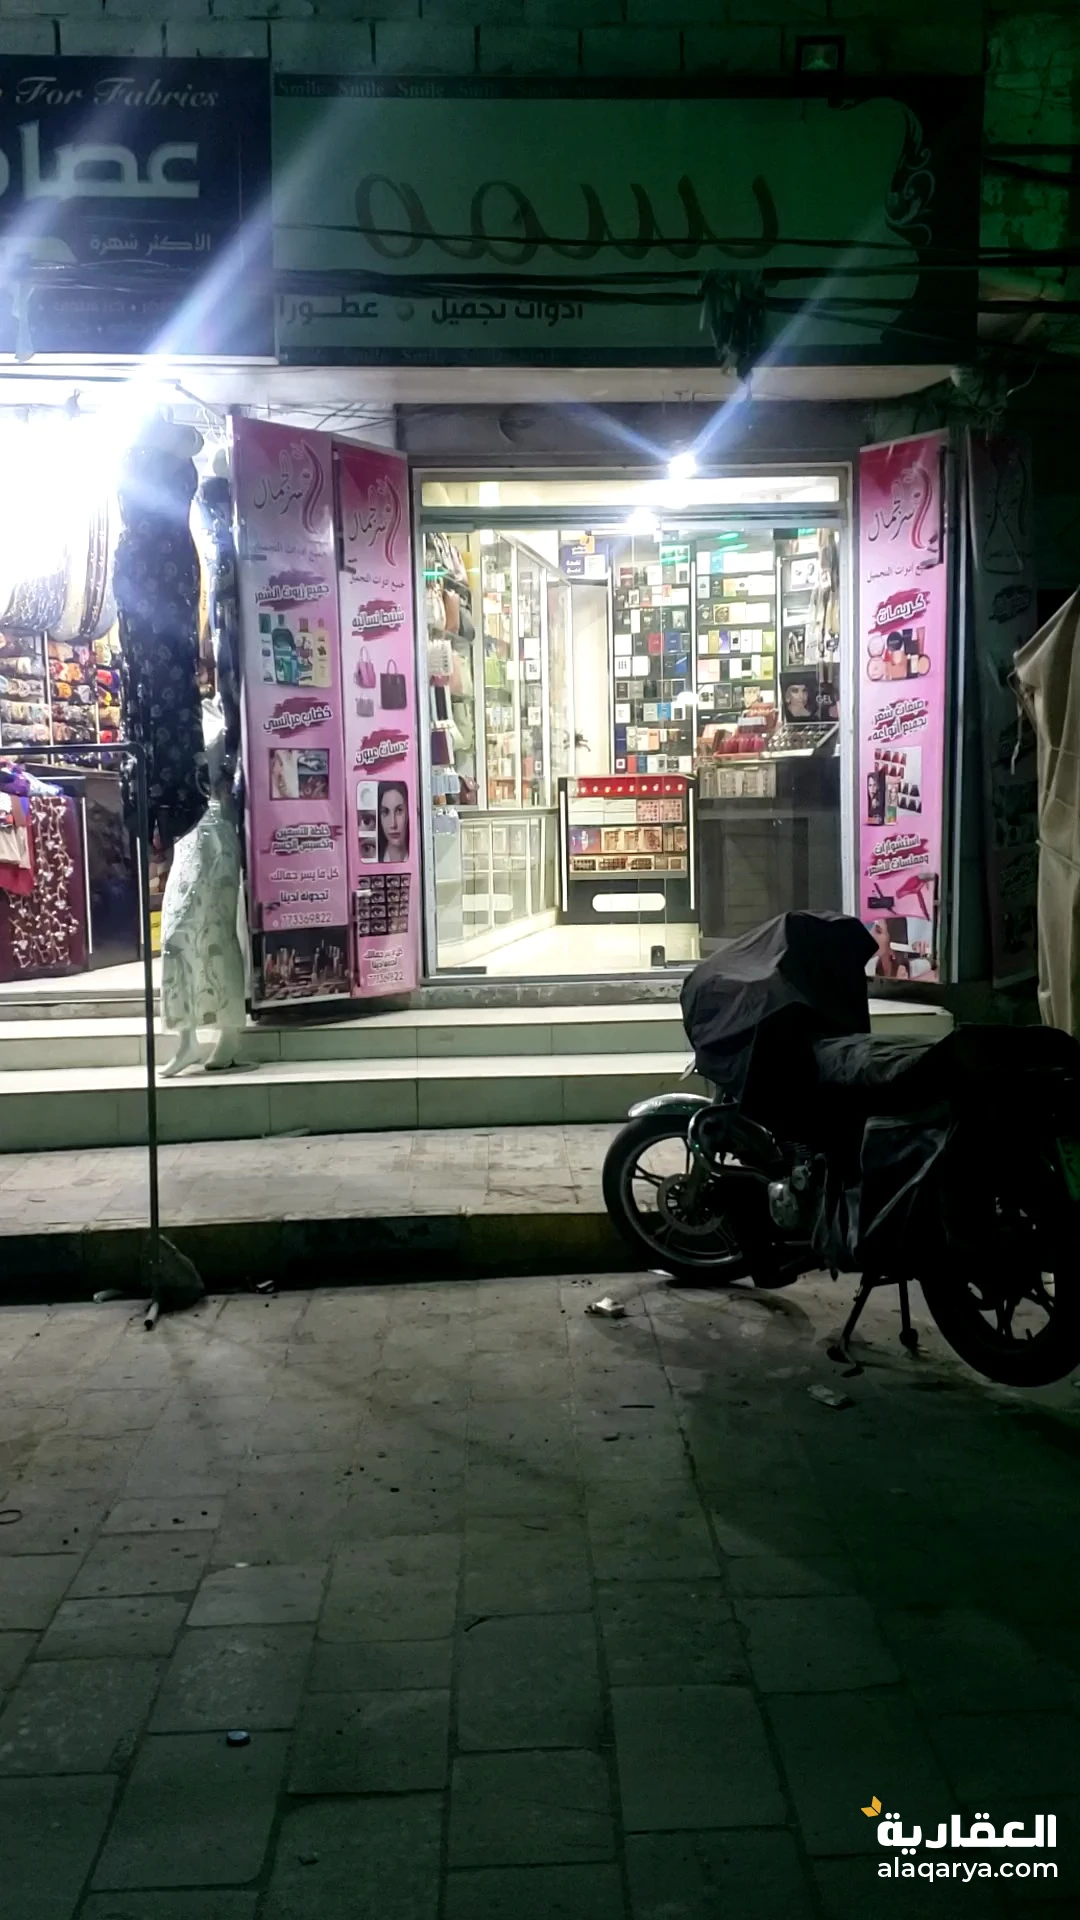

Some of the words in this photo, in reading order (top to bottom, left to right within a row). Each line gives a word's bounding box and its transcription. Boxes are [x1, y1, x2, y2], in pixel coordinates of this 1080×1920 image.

[15, 76, 84, 105] For
[94, 77, 219, 108] Fabrics
[0, 119, 199, 200] عصا
[877, 593, 926, 625] كريمات
